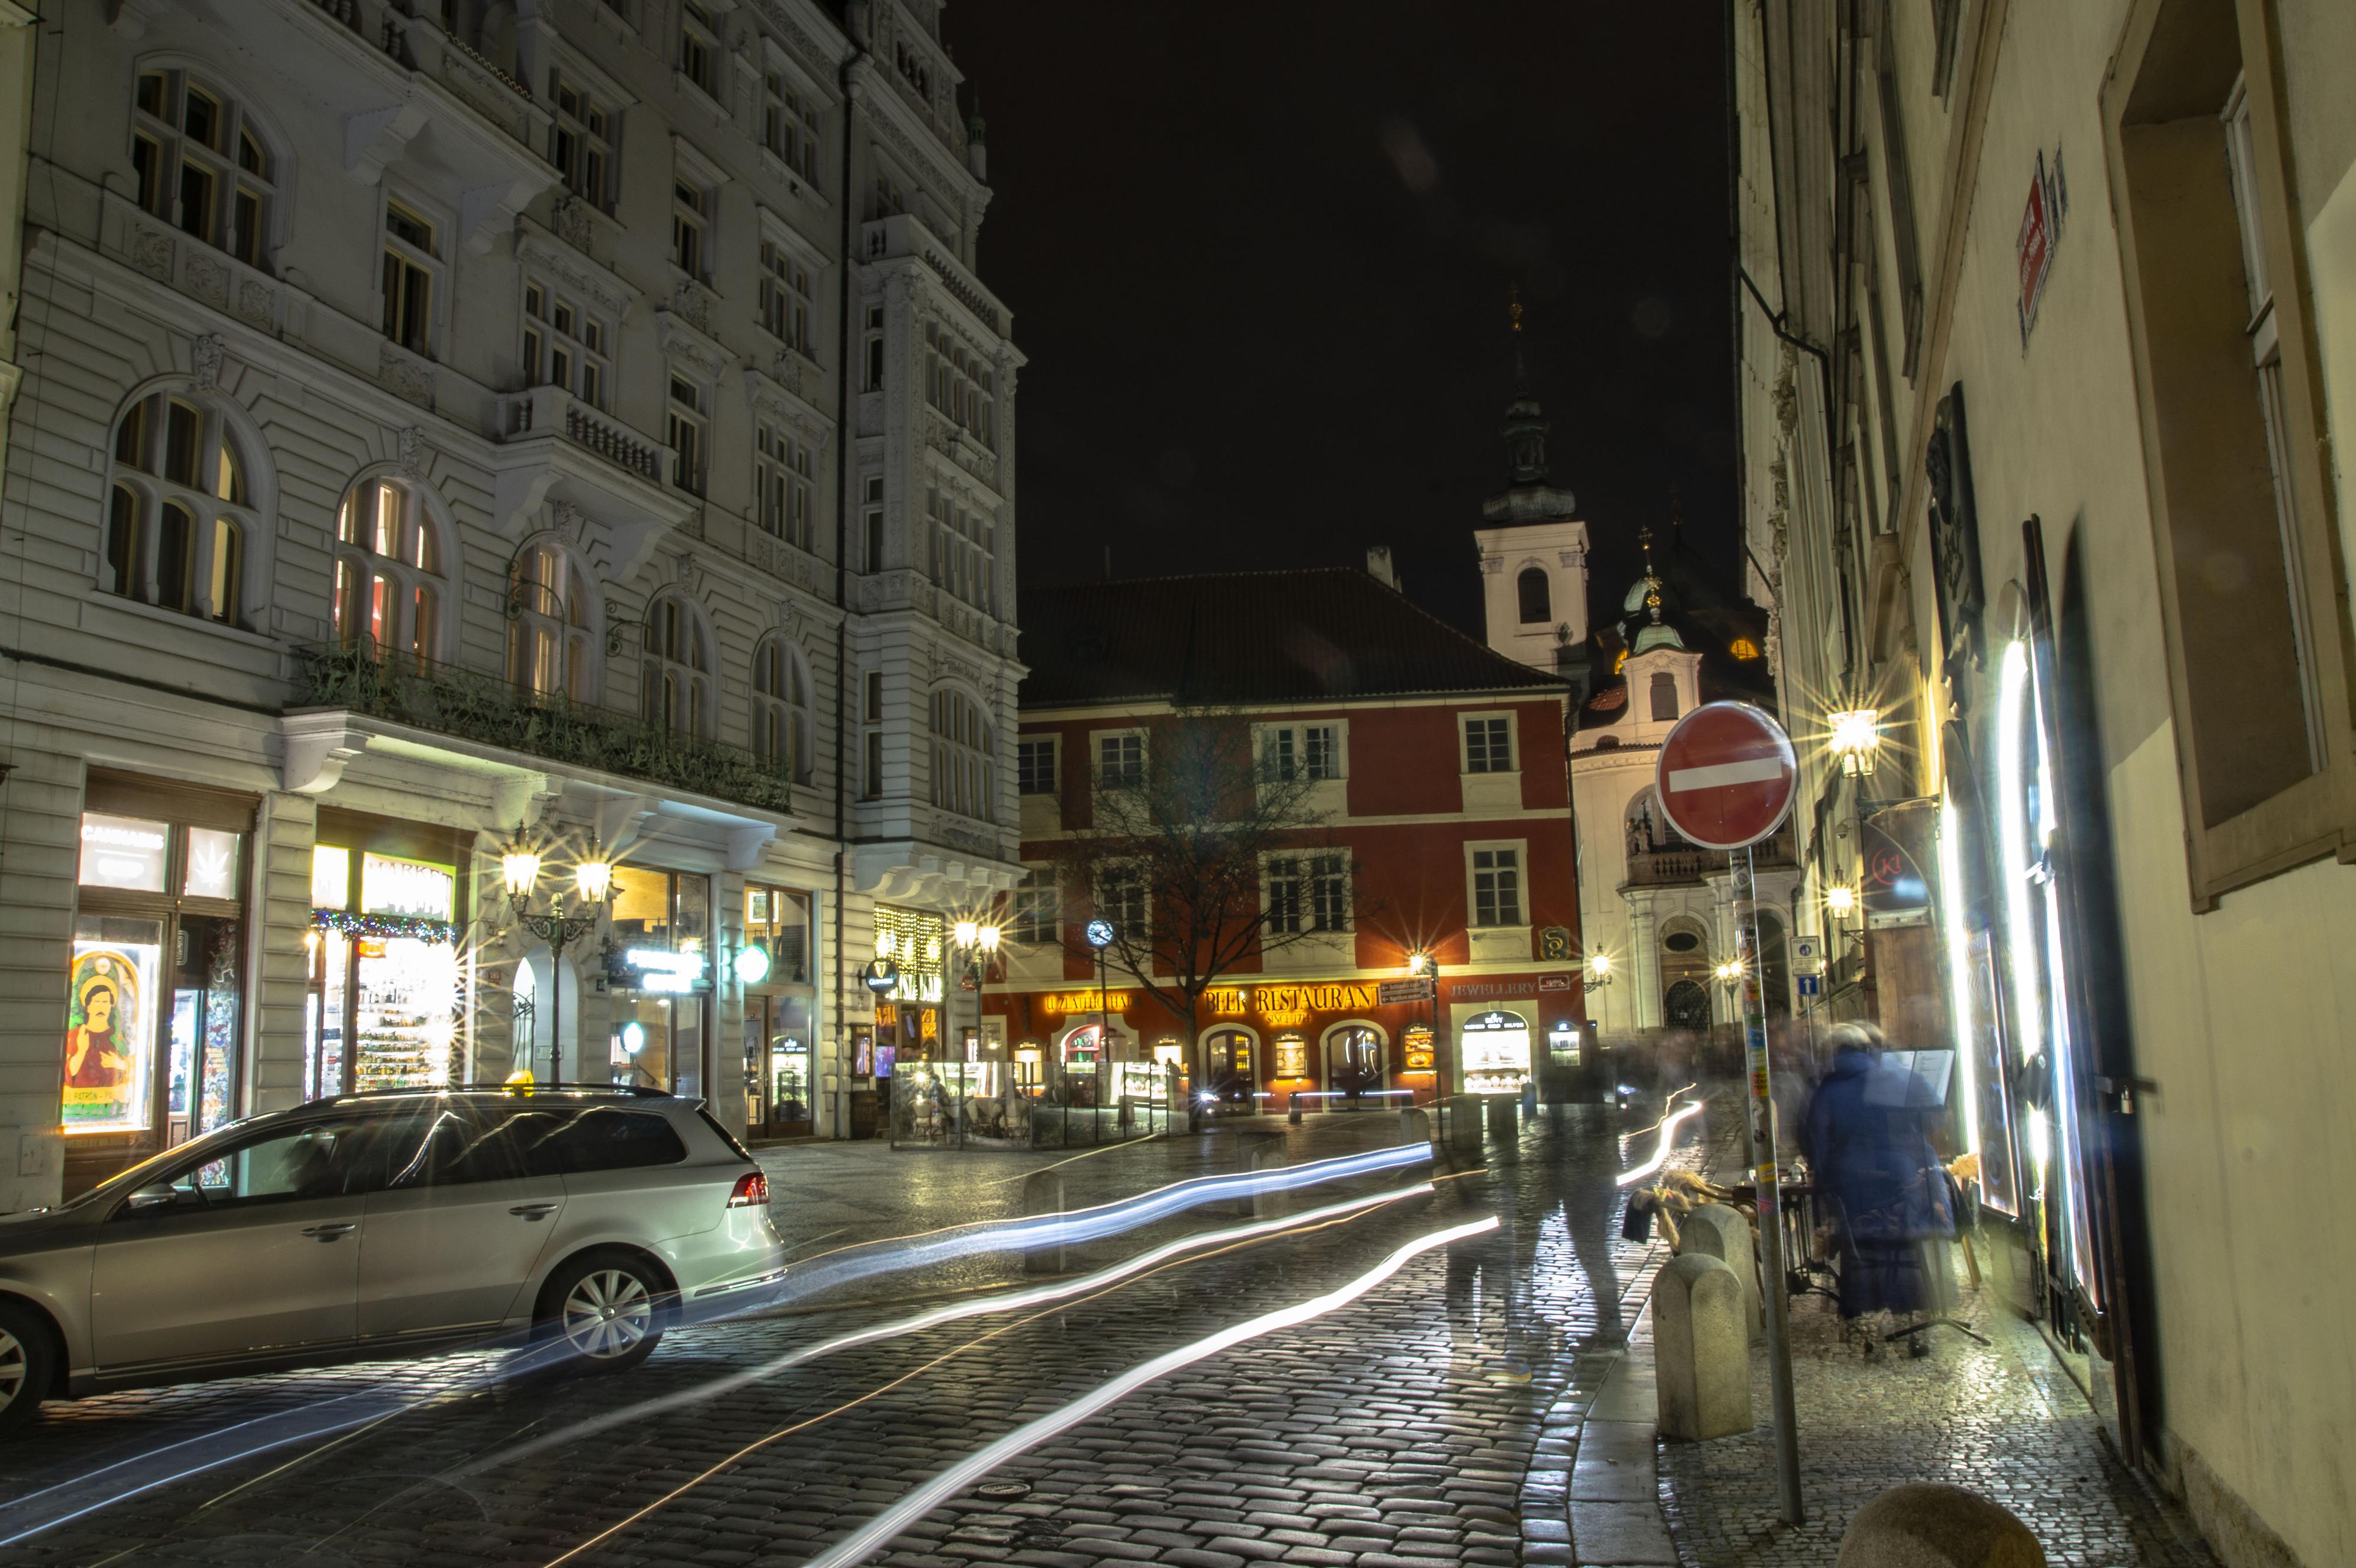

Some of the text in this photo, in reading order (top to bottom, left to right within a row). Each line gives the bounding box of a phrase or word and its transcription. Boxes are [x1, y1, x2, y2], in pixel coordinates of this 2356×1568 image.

[1451, 983, 1536, 996] JEWELLERY
[1047, 997, 1054, 1010] U
[1206, 987, 1380, 1011] BEER RESTAURANT
[1268, 1014, 1311, 1024] SINCE 1714
[74, 1092, 98, 1101] PATRON
